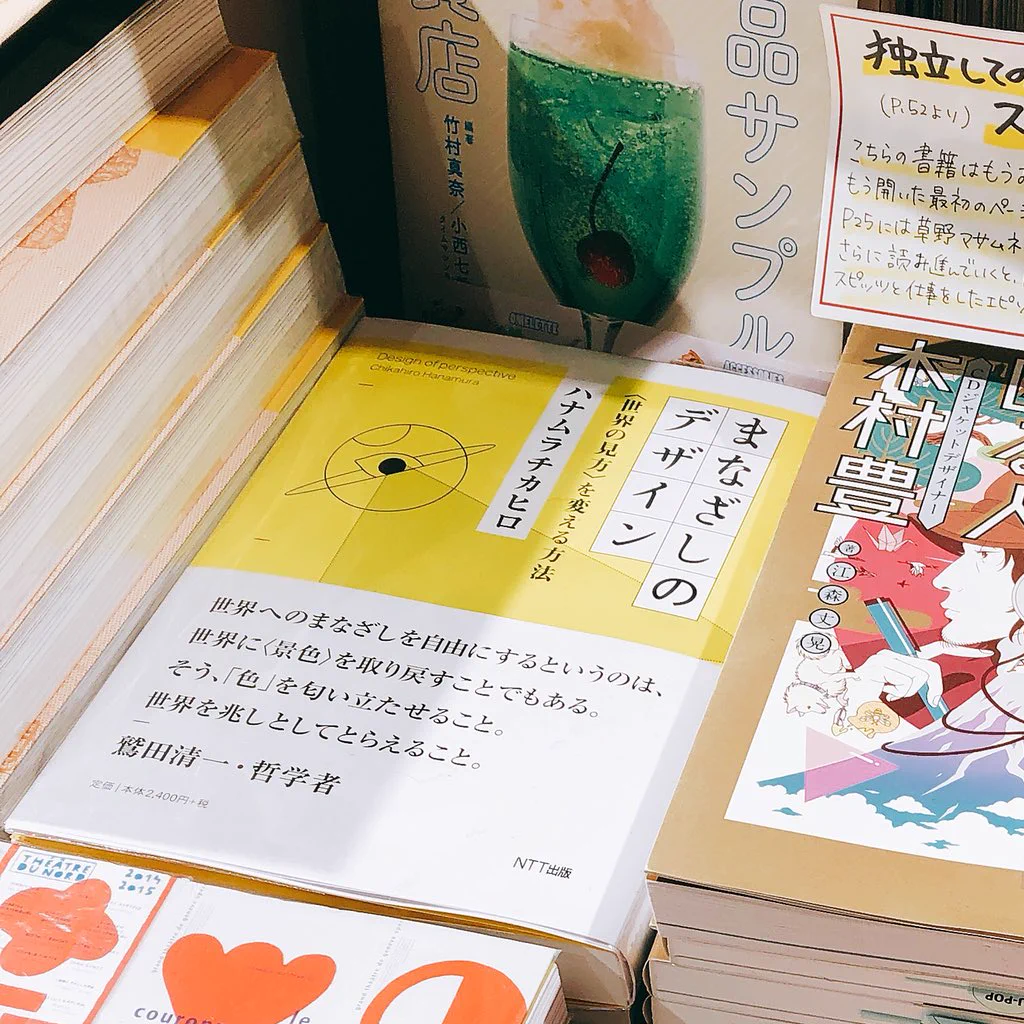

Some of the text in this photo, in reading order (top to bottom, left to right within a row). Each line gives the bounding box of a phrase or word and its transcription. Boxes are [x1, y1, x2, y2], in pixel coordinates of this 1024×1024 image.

[726, 0, 799, 359] 品サンプル
[369, 363, 480, 386] Chikahiro Hanamura
[376, 352, 517, 381] Design of perspective
[496, 386, 592, 531] ハナムラチカヒロ
[611, 407, 720, 547] デザイン
[813, 339, 961, 528] 木村豊
[651, 417, 770, 608] まなざしの
[209, 595, 665, 697] 世界へのまなざしを自由にするというのは、
[111, 735, 342, 796] 鷲田清一・哲学者
[144, 690, 482, 771] 世界を兆しとしてとらえること。
[42, 868, 86, 881] NORD
[512, 856, 574, 881] NTT出版
